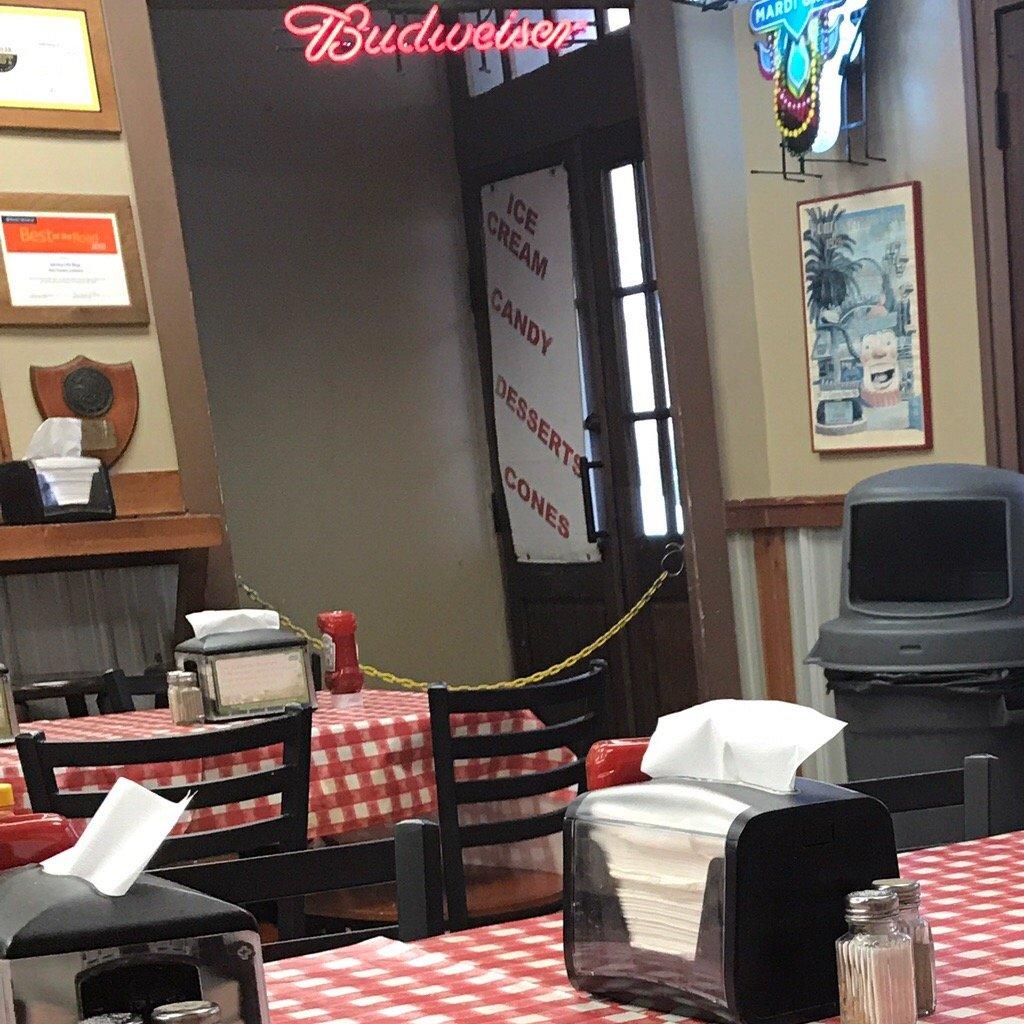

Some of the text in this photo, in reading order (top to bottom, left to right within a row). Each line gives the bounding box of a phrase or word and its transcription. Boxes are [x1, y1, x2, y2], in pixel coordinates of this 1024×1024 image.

[283, 3, 583, 63] Budweiser
[755, 0, 798, 24] MARDI
[486, 210, 549, 280] CREAM
[506, 192, 538, 236] ICE
[490, 286, 553, 357] CANDY
[495, 374, 583, 478] DESSERTS
[504, 466, 570, 540] CONES
